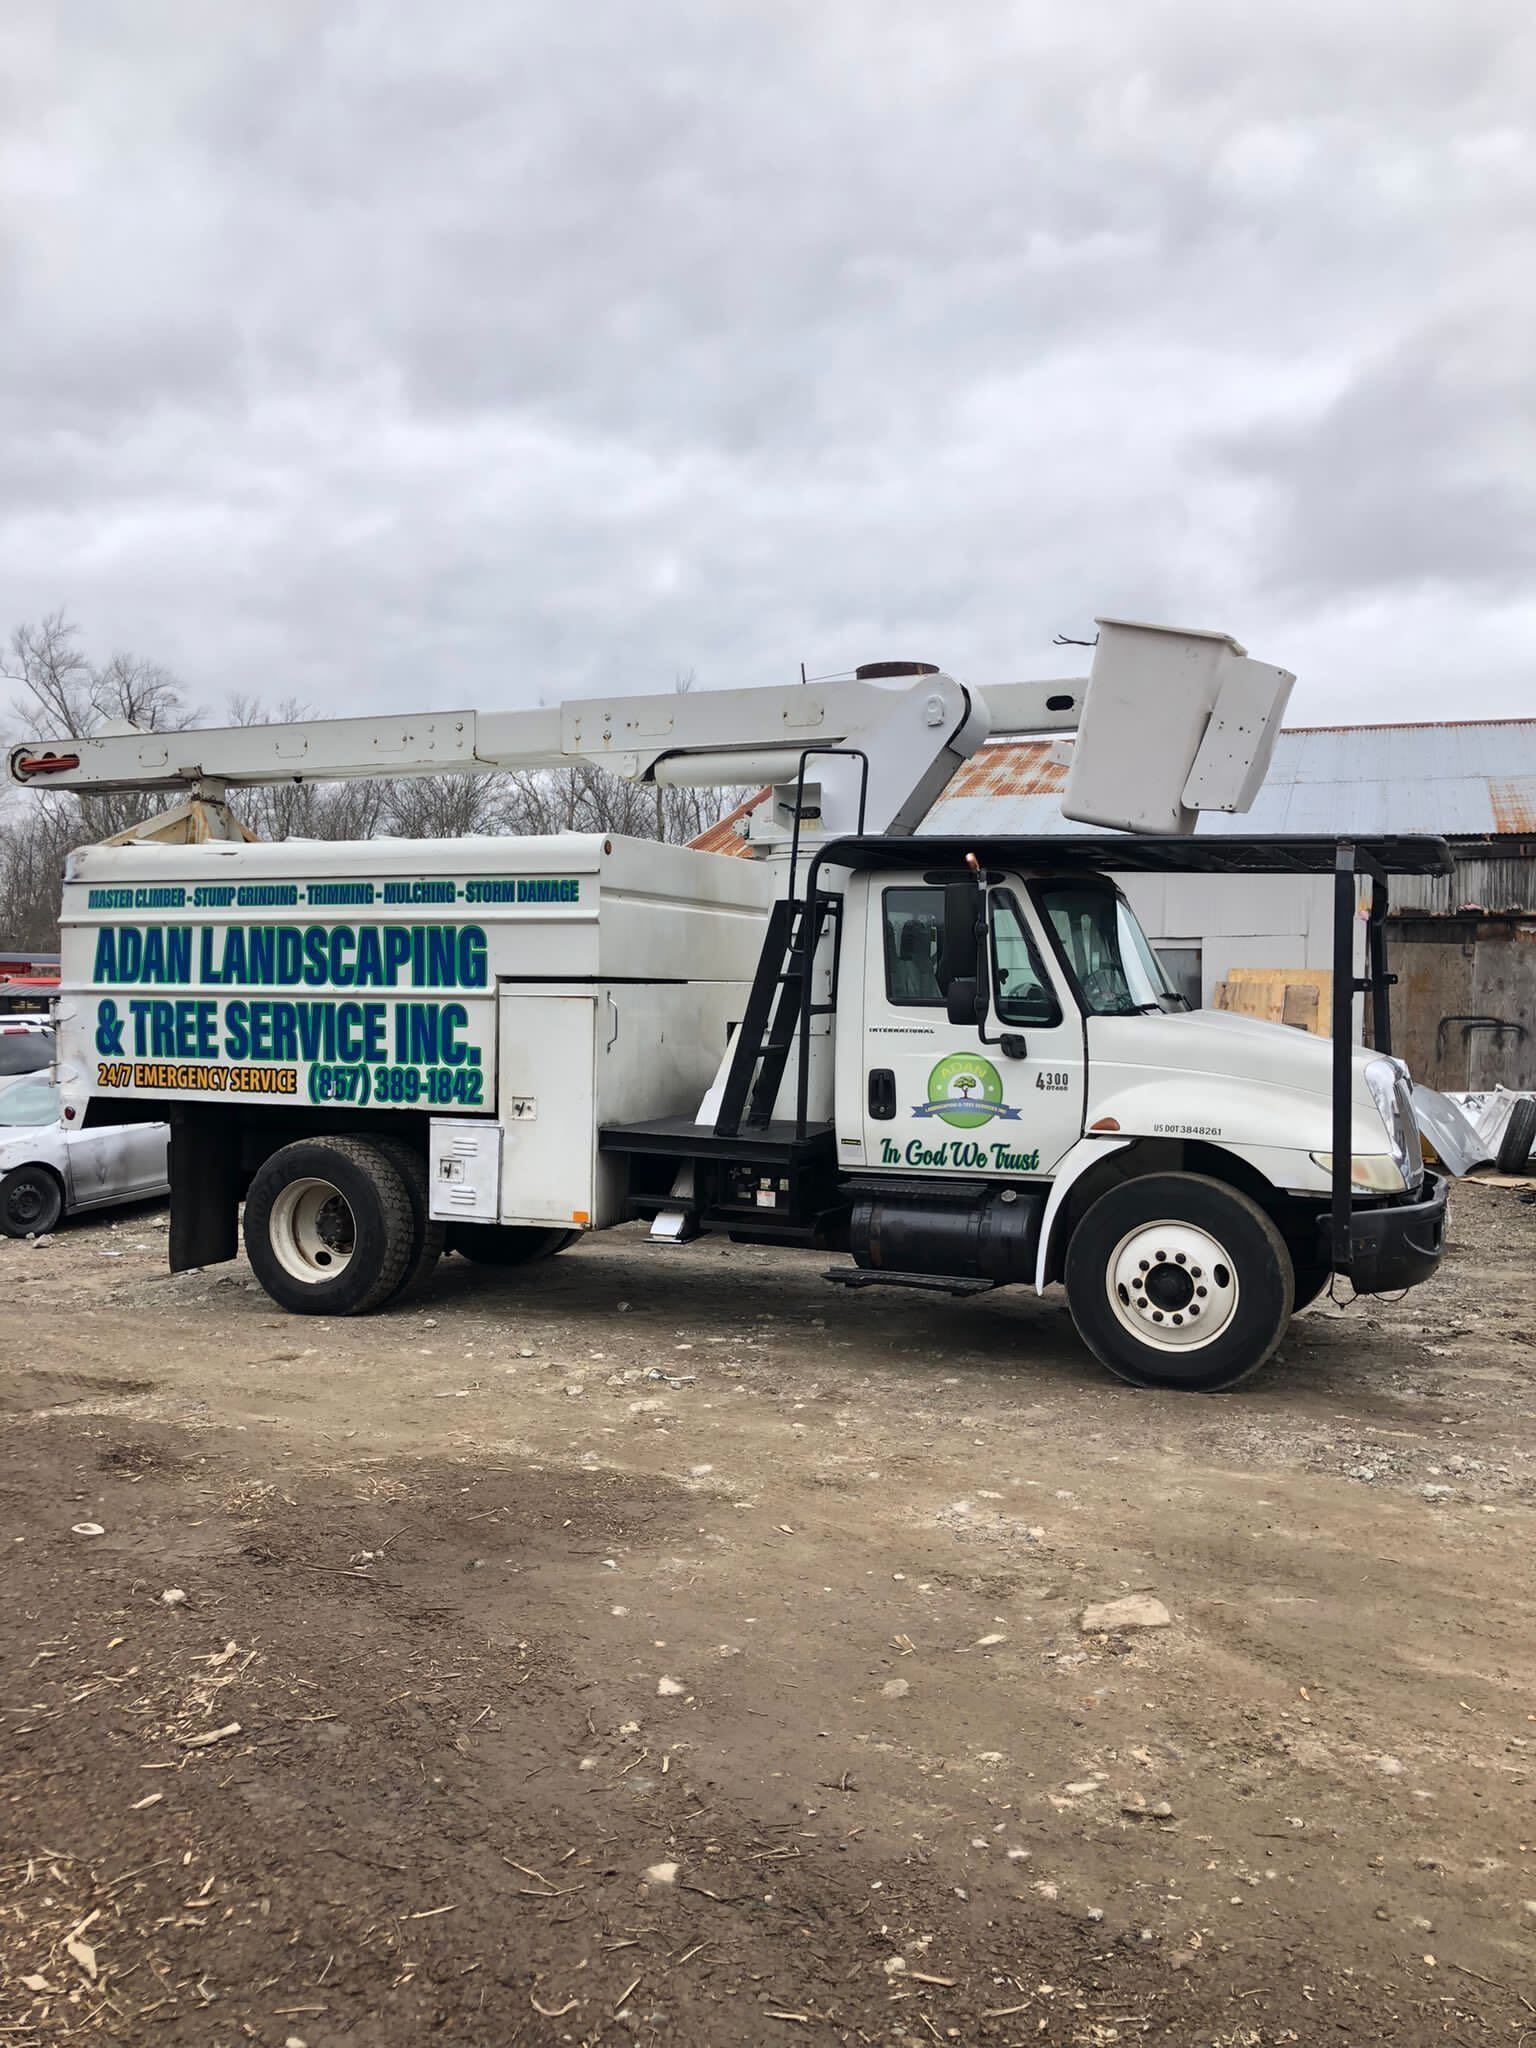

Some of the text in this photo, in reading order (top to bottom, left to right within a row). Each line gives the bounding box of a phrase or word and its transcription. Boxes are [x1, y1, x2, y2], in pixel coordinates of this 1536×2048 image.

[88, 889, 133, 909] MASTER
[135, 887, 186, 908] CLIMBER
[194, 886, 236, 907] STUMP
[237, 884, 298, 906] GRINDING
[306, 882, 374, 905] TRIMMING
[383, 881, 456, 904] MULCHING
[465, 880, 515, 903] STORM
[517, 879, 580, 902] DAMAGE
[93, 924, 488, 989] ADAN LANDSCAPING
[95, 998, 481, 1067] & TREE SERVICE INC.
[97, 1063, 297, 1093] 24/7 EMERGENCY SERVICE
[307, 1062, 483, 1106] (857) 389-1842
[941, 1062, 986, 1078] ADAN
[1035, 1071, 1069, 1090] 4300
[1153, 1124, 1222, 1136] US DOT 3848261
[880, 1138, 1040, 1171] In God We Trust
